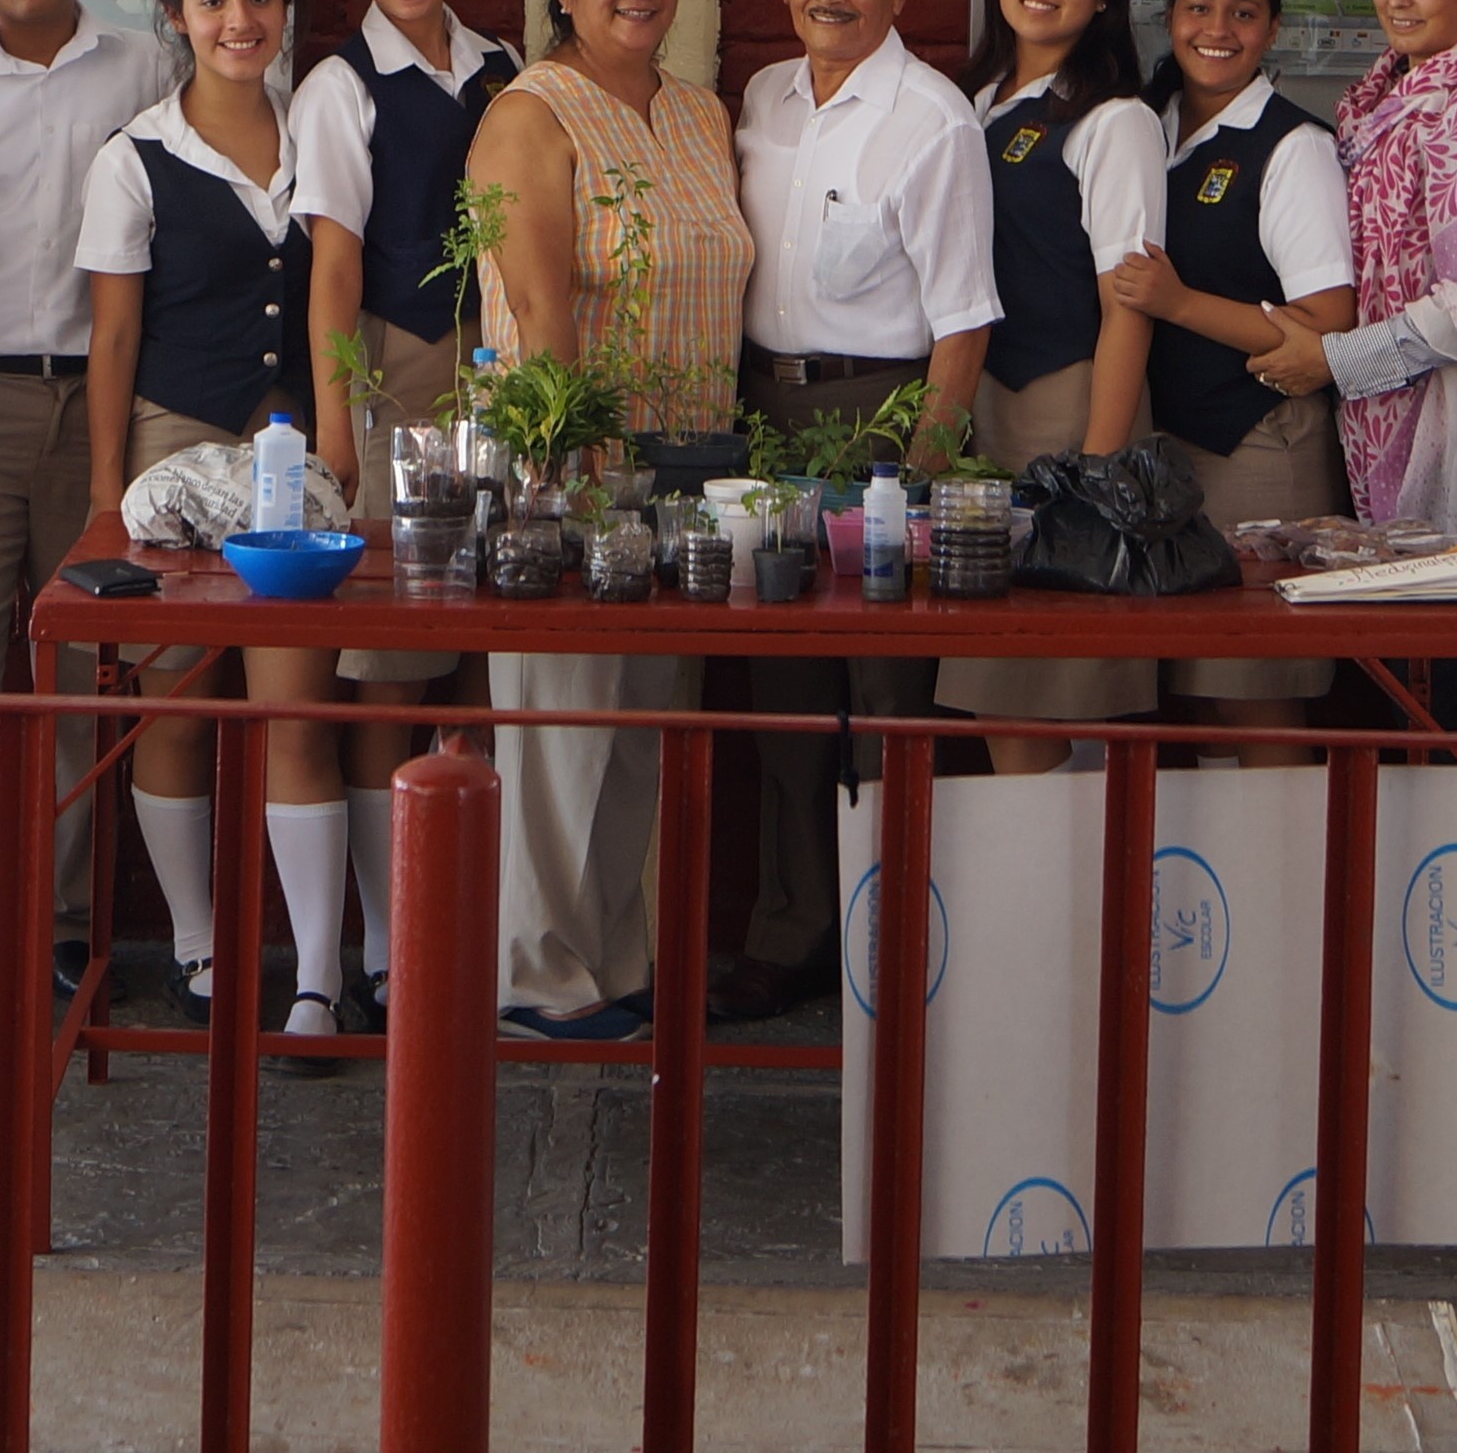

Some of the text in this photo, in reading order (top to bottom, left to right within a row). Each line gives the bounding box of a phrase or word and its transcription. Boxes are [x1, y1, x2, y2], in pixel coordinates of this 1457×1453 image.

[172, 467, 245, 508] blanco dejan las
[1163, 909, 1196, 951] Vic
[1200, 899, 1213, 960] ESCOLAR
[1428, 865, 1445, 987] ILUSTRACION
